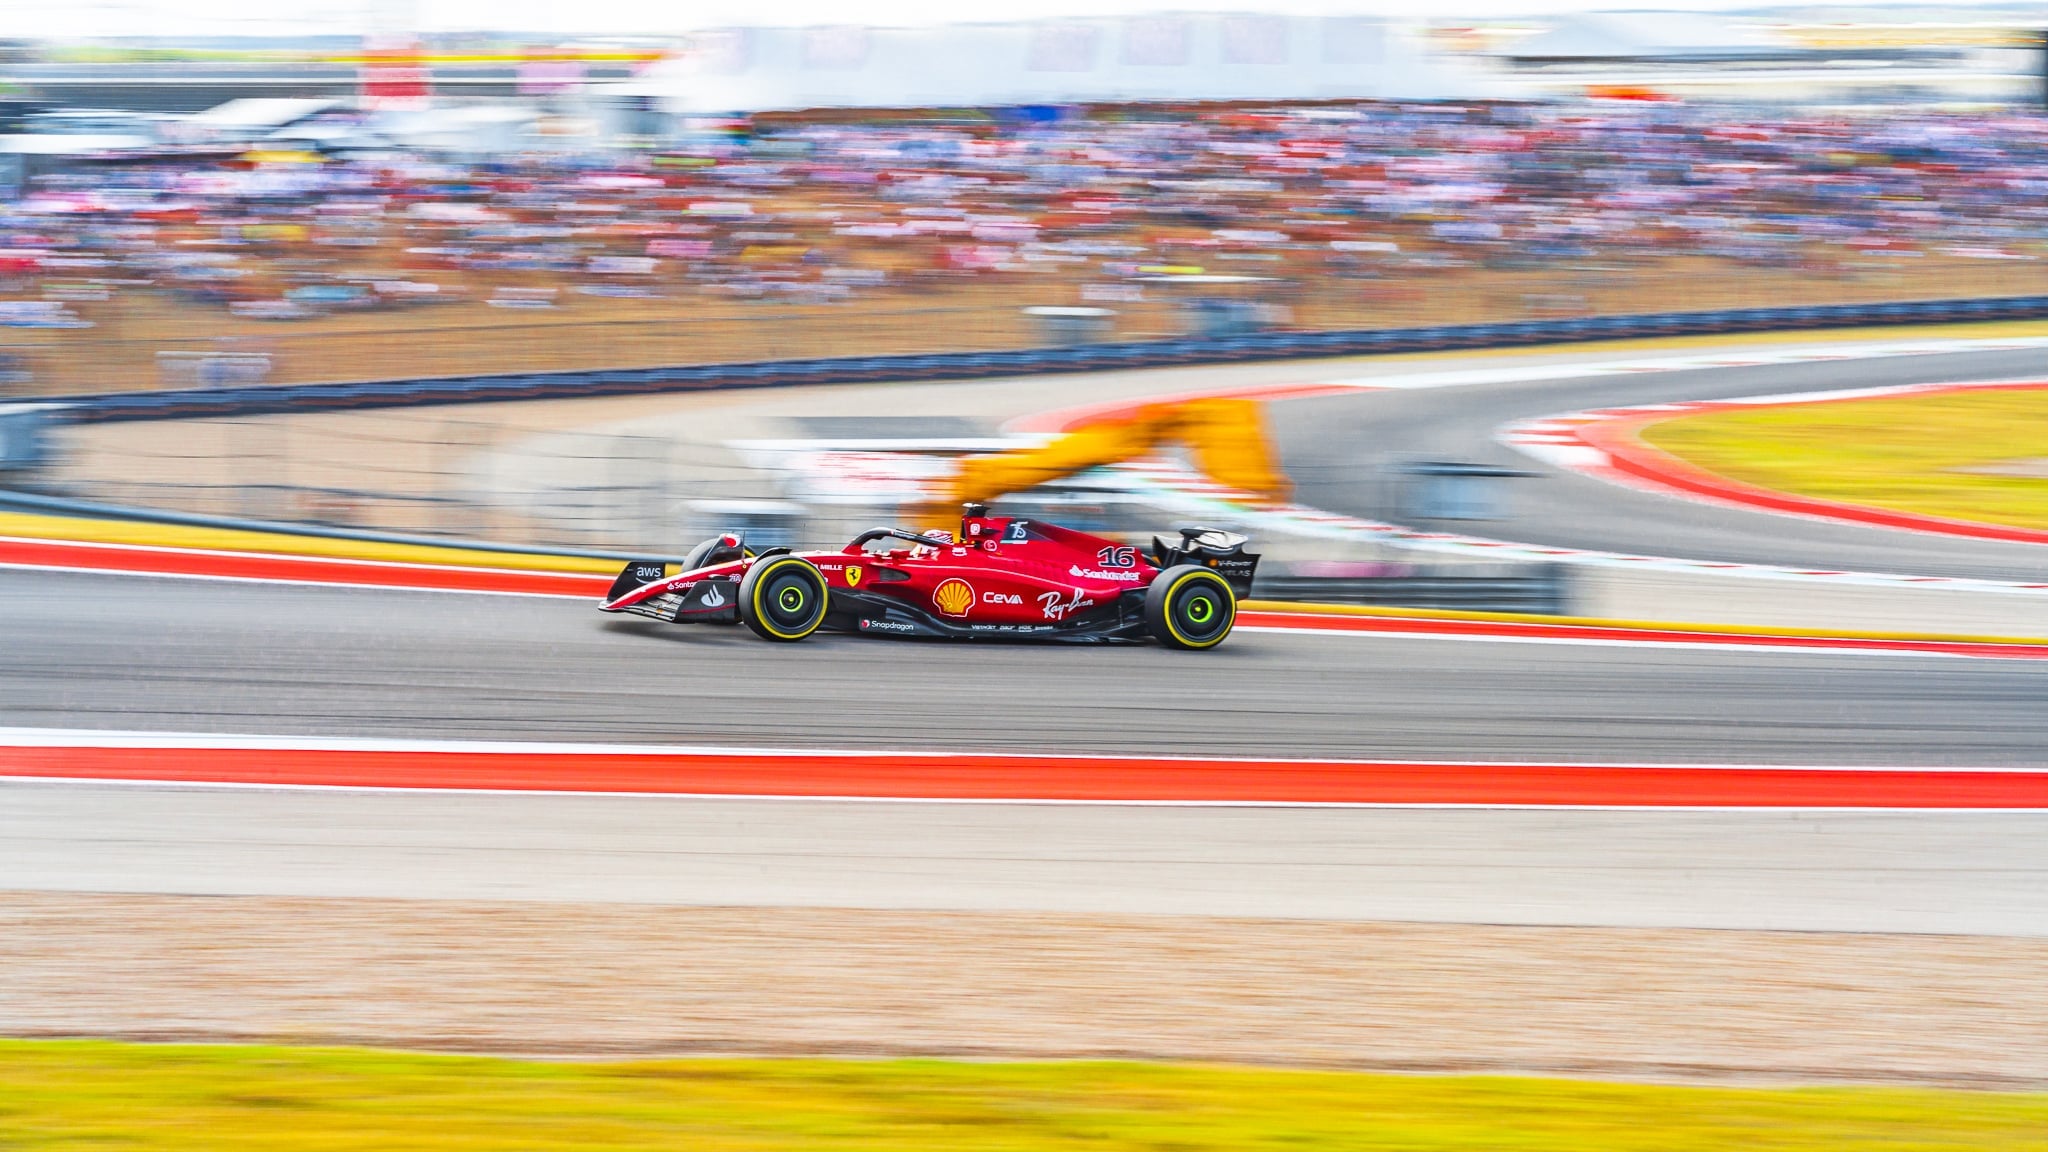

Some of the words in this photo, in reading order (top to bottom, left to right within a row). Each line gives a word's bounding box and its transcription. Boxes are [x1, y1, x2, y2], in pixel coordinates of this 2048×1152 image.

[1097, 546, 1136, 568] 16
[636, 566, 661, 577] aws
[1082, 568, 1141, 581] Santander
[1037, 587, 1093, 620] Ray-Ban
[871, 620, 914, 631] Snapdragon
